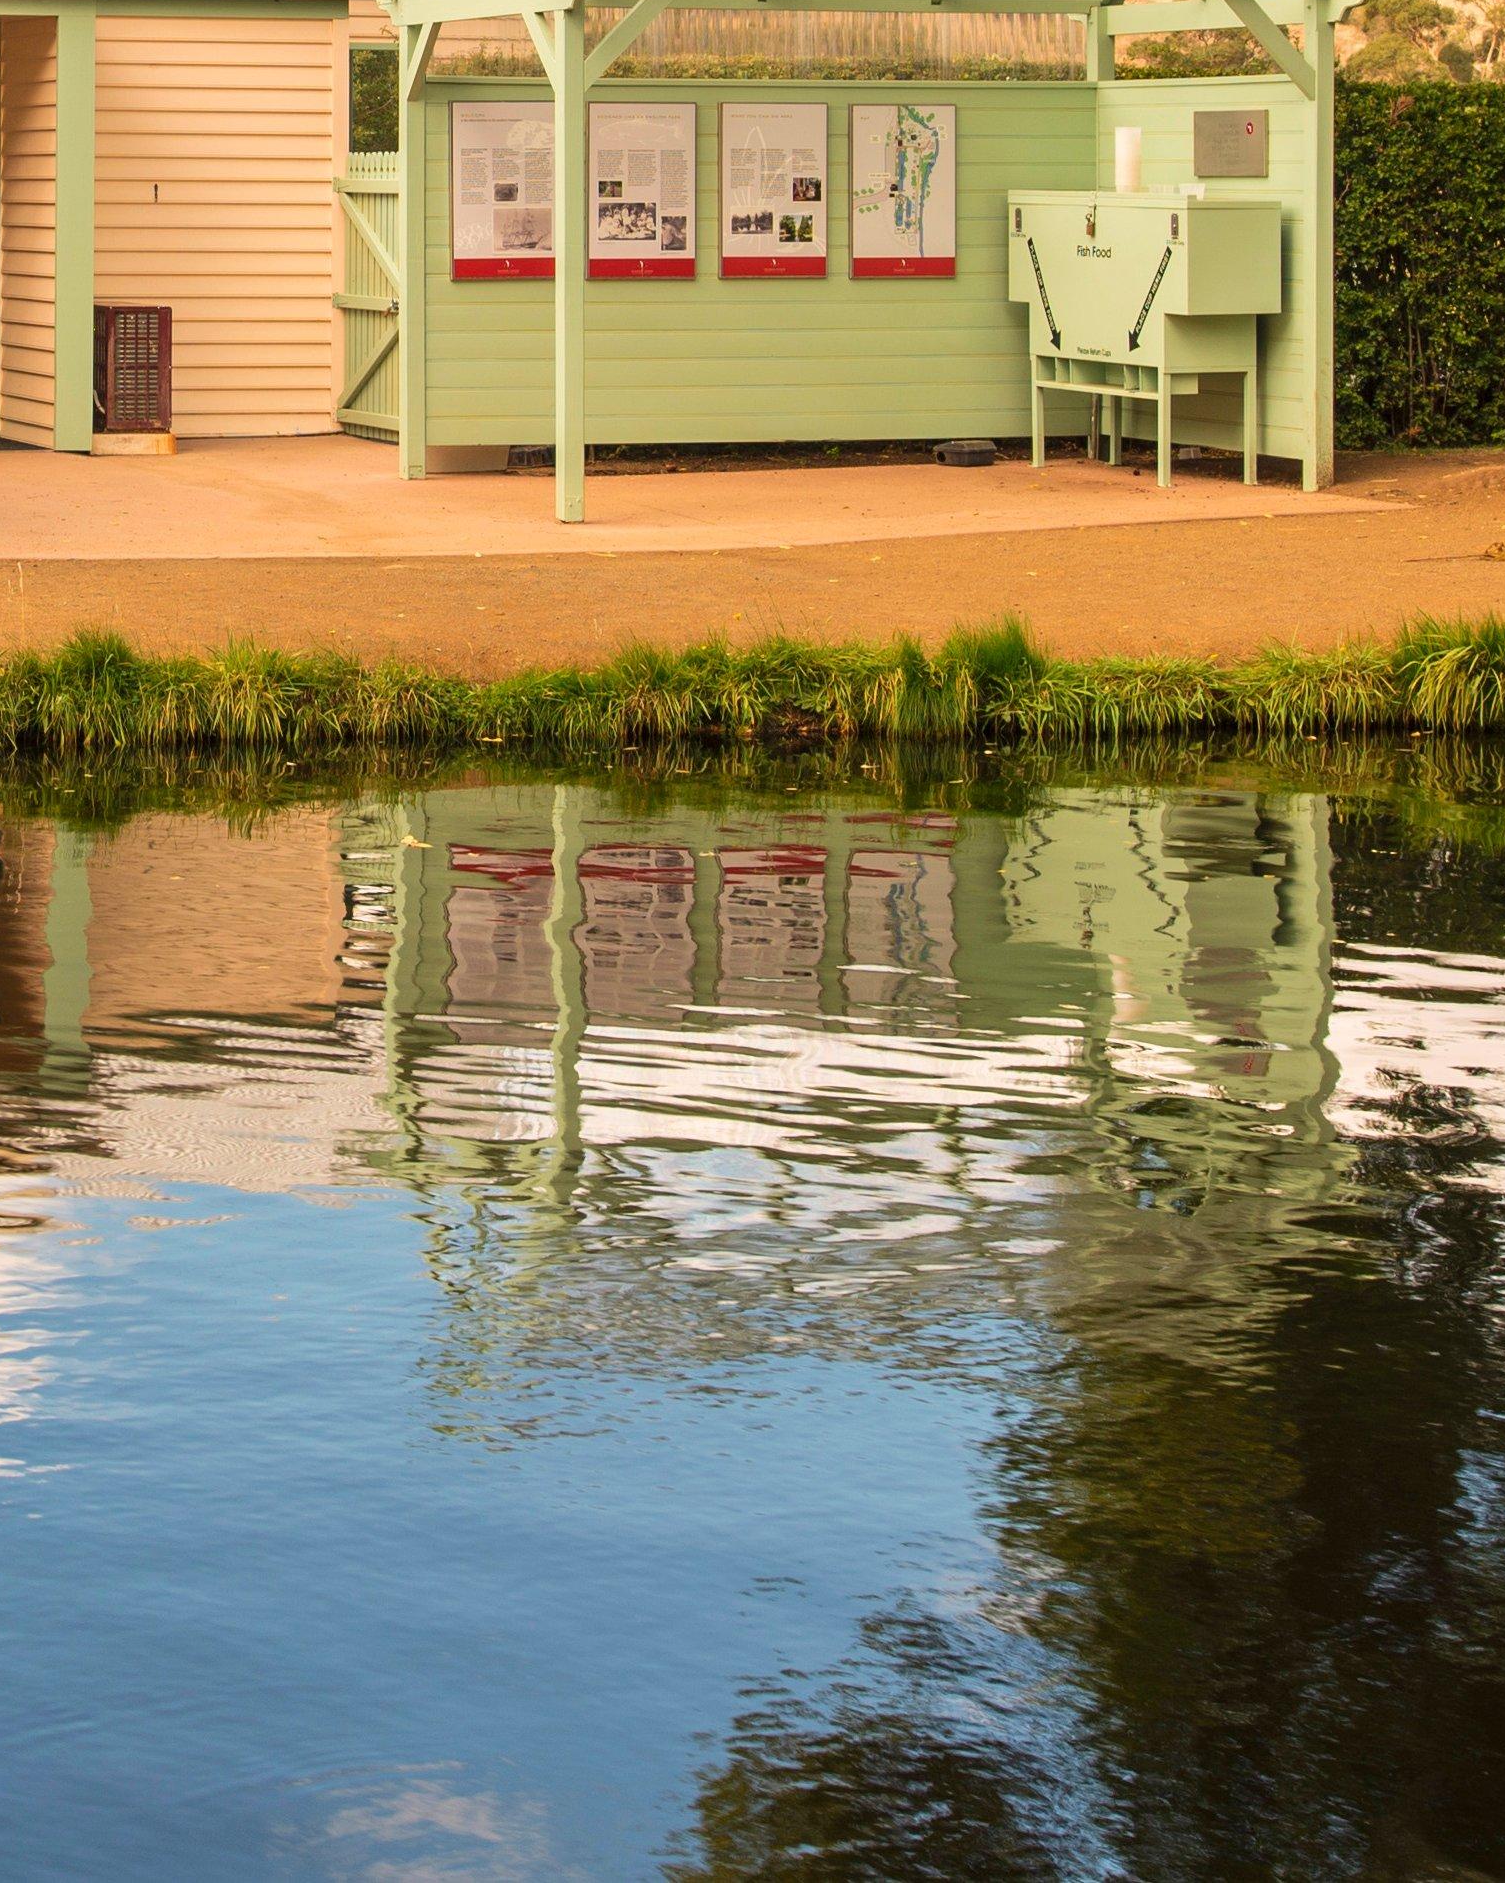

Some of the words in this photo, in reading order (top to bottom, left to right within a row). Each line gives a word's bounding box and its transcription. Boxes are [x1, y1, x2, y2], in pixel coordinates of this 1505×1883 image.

[1077, 245, 1091, 257] Fish
[1092, 246, 1111, 258] Food
[1135, 310, 1146, 334] PLACE
[1145, 293, 1153, 310] CUP
[1151, 273, 1162, 293] HERE
